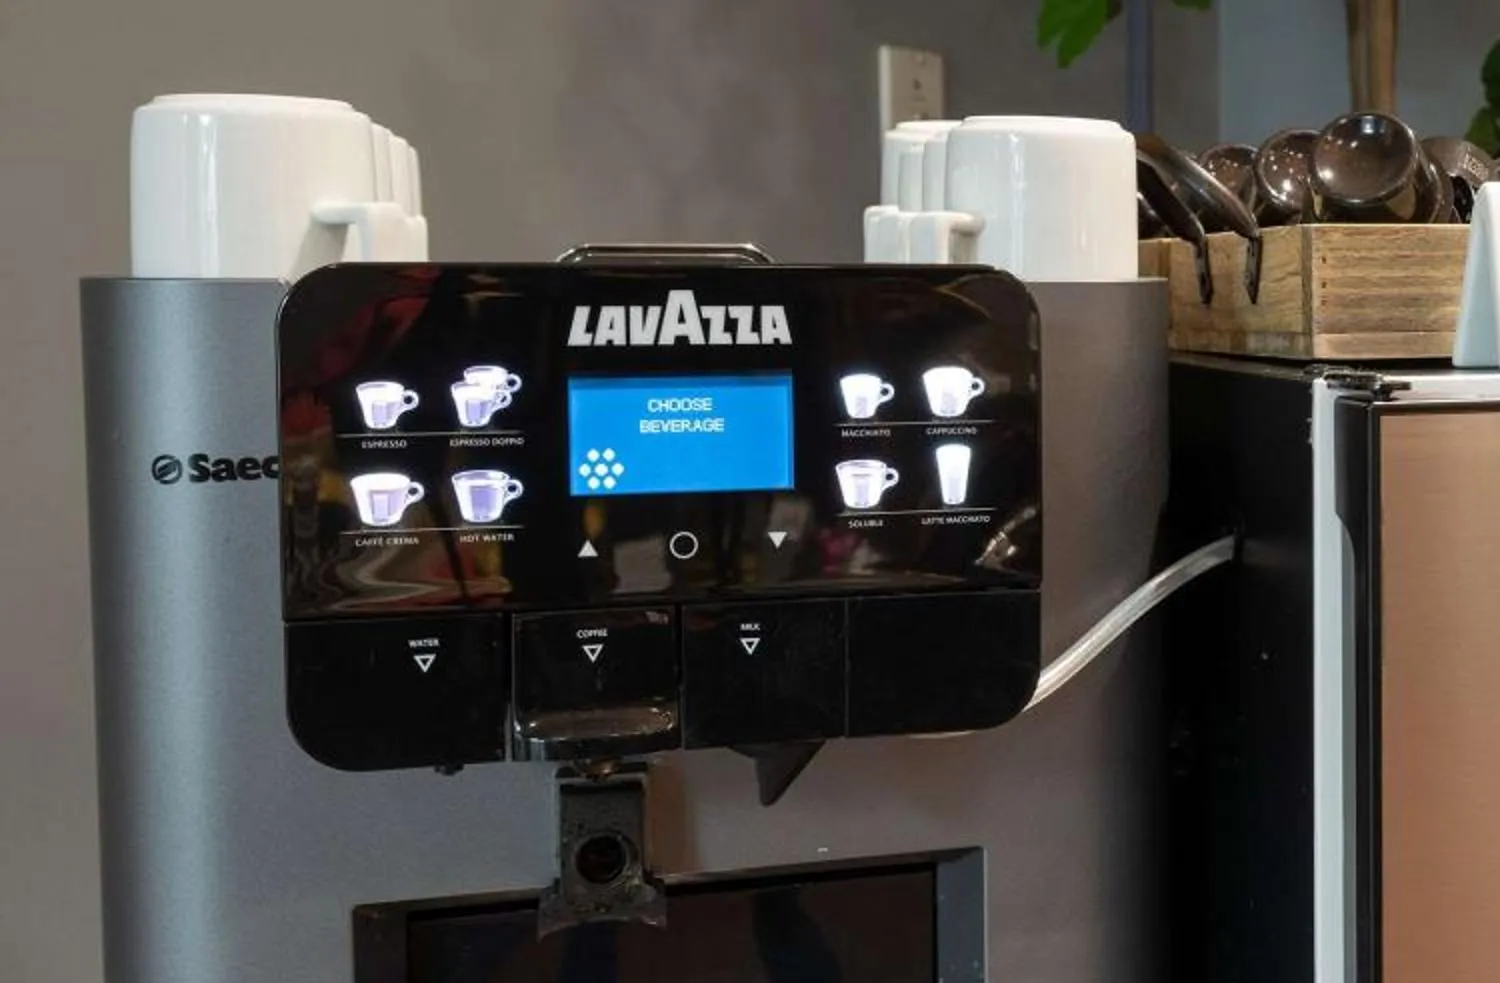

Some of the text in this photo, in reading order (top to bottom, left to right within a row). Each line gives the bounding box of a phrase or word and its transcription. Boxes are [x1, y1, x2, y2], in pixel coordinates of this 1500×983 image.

[567, 288, 794, 346] LAVAZZA
[647, 397, 713, 413] CHOOSE
[639, 417, 725, 434] BEVERAGE
[841, 428, 891, 438] MACCHIATO
[925, 427, 977, 436] CAPPUCCINO
[361, 439, 408, 449] ESPRESSO
[449, 437, 490, 447] ESPRESSO
[187, 452, 280, 483] Saec
[920, 515, 991, 526] LATTE MACCHIATO
[385, 536, 419, 546] CREMA
[459, 533, 515, 544] HOT WATER
[740, 622, 761, 632] MILK
[576, 628, 608, 639] COFFEE
[408, 638, 440, 648] WATER
